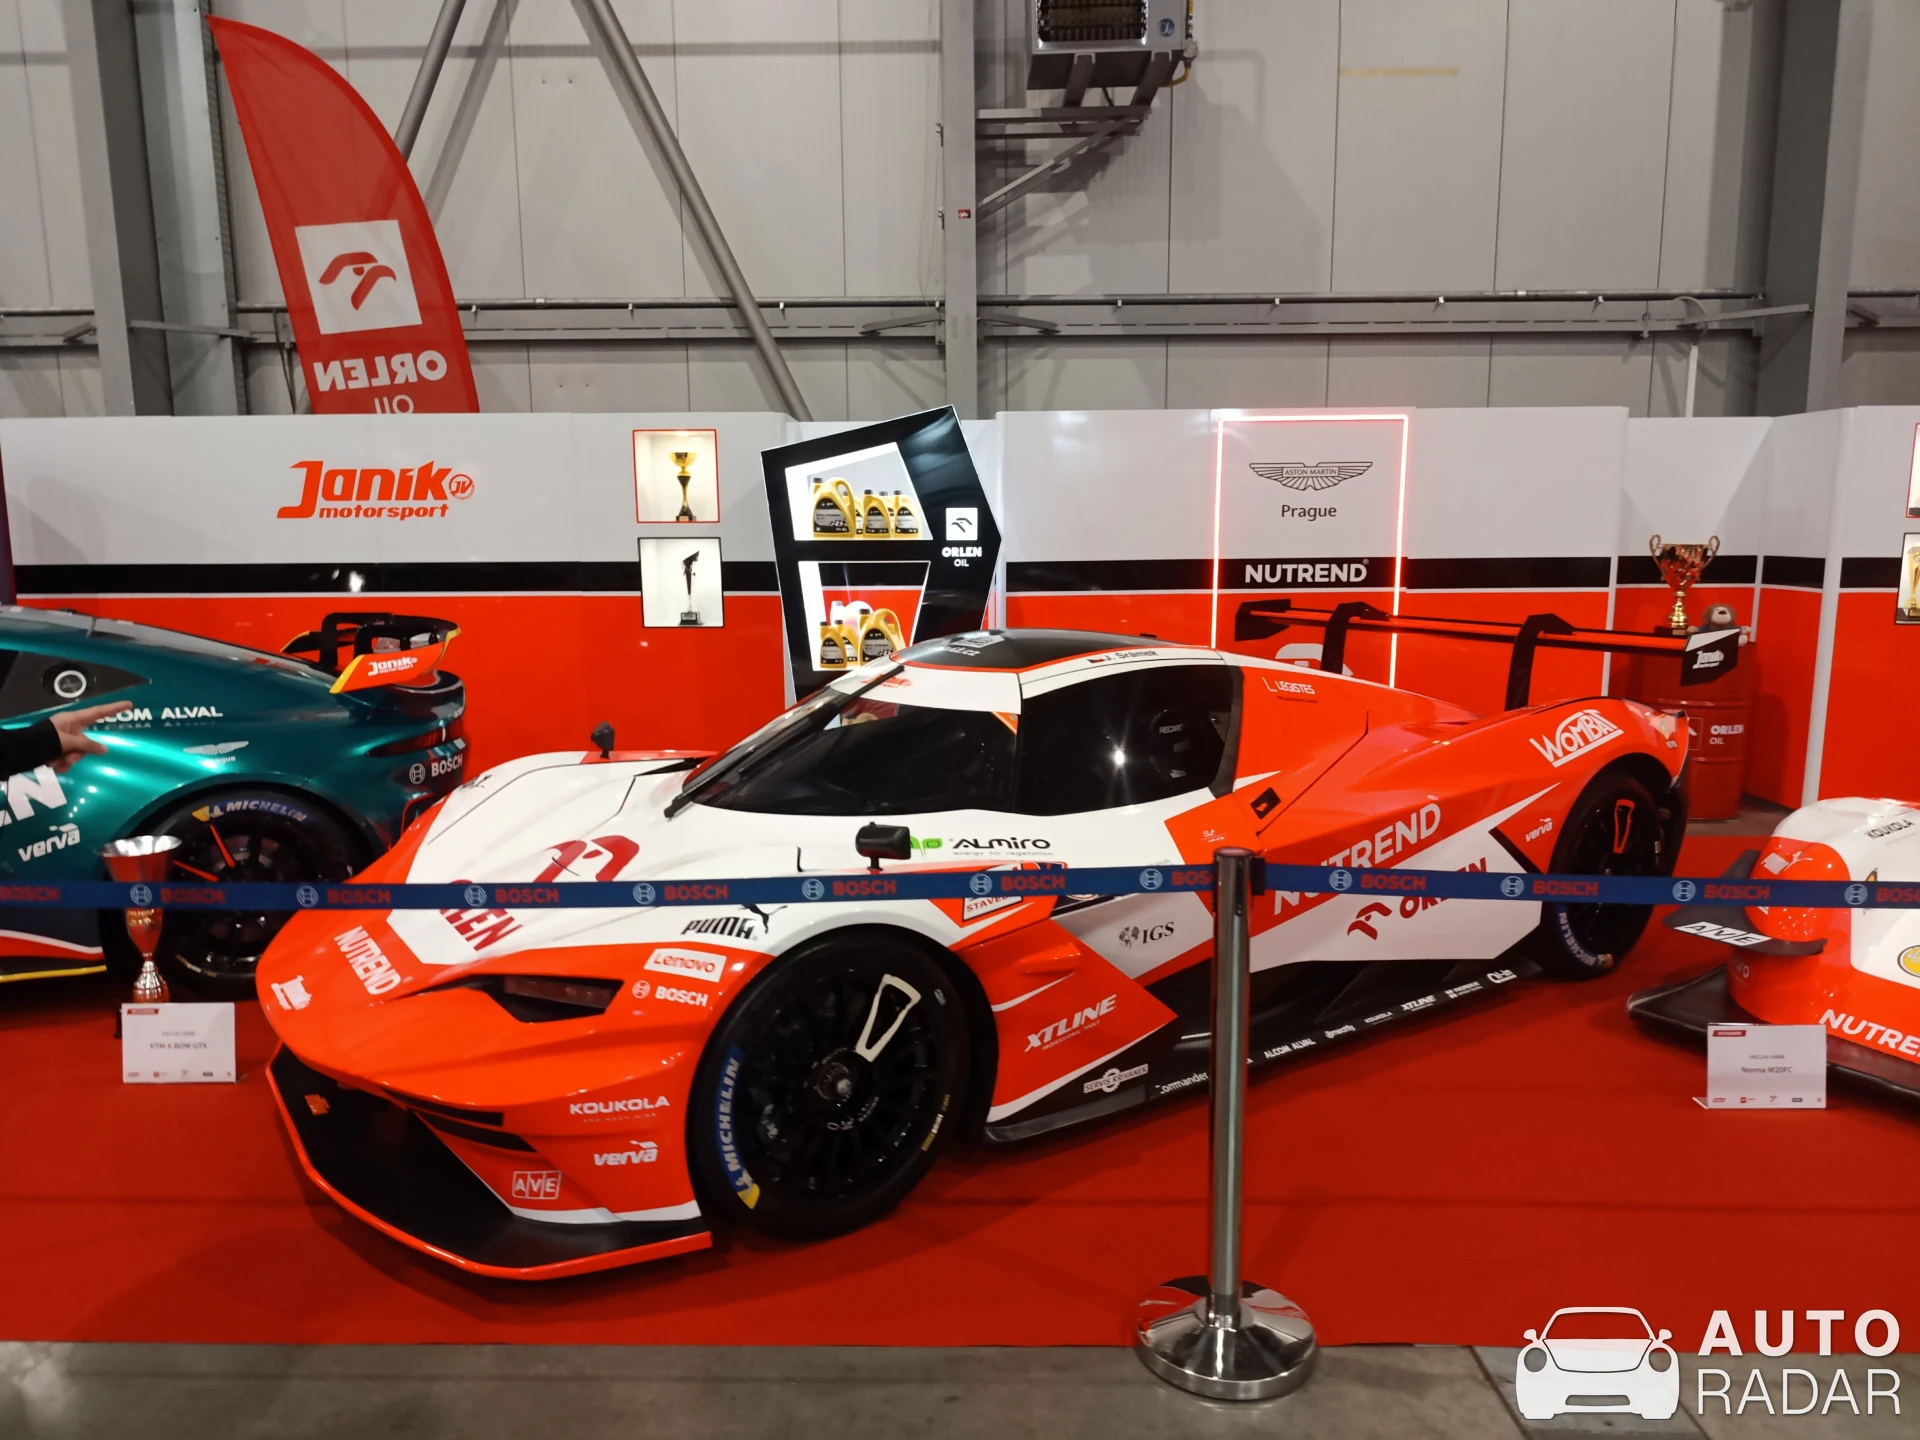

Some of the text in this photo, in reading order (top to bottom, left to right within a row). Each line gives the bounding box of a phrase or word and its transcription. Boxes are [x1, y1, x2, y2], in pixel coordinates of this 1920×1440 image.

[1284, 468, 1338, 476] ASTON MARTIN
[319, 504, 450, 521] motorsport
[1281, 504, 1337, 522] Prague
[942, 546, 983, 558] ORLEN
[954, 559, 969, 568] OIL
[161, 705, 224, 719] ALVAL
[1528, 709, 1620, 764] WOMBAT
[1710, 724, 1744, 736] ORLEN
[1709, 737, 1725, 745] OIL
[431, 754, 463, 777] BOSCH
[225, 799, 308, 821] MICHELIN
[1525, 820, 1553, 842] verva
[1864, 819, 1915, 840] KOUKOLA
[18, 828, 80, 862] verva
[1000, 875, 1066, 892] BOSCH
[1171, 870, 1213, 886] BOS
[1360, 873, 1427, 891] BOSCH
[160, 887, 226, 903] BOSCH
[326, 888, 391, 904] BOSCH
[495, 887, 560, 904] BOSCH
[663, 884, 729, 901] BOSCH
[832, 879, 897, 897] BOSCH
[1531, 879, 1599, 896] BOSCH
[1703, 883, 1771, 900] BOSCH
[680, 916, 756, 941] PUMA
[1141, 921, 1175, 945] IGS
[1684, 925, 1762, 945] AVE
[332, 925, 402, 995] NUTREND
[653, 952, 716, 973] Lenovo
[654, 985, 709, 1008] BOSCH
[1024, 994, 1117, 1053] XTLINE
[1818, 1008, 1920, 1057] NUTRE
[1263, 1037, 1317, 1059] ALCOM ALVAL
[569, 1095, 670, 1115] KOUKOLA
[718, 1057, 741, 1173] MICHELIN
[593, 1145, 659, 1167] verva
[514, 1177, 558, 1194] AVE
